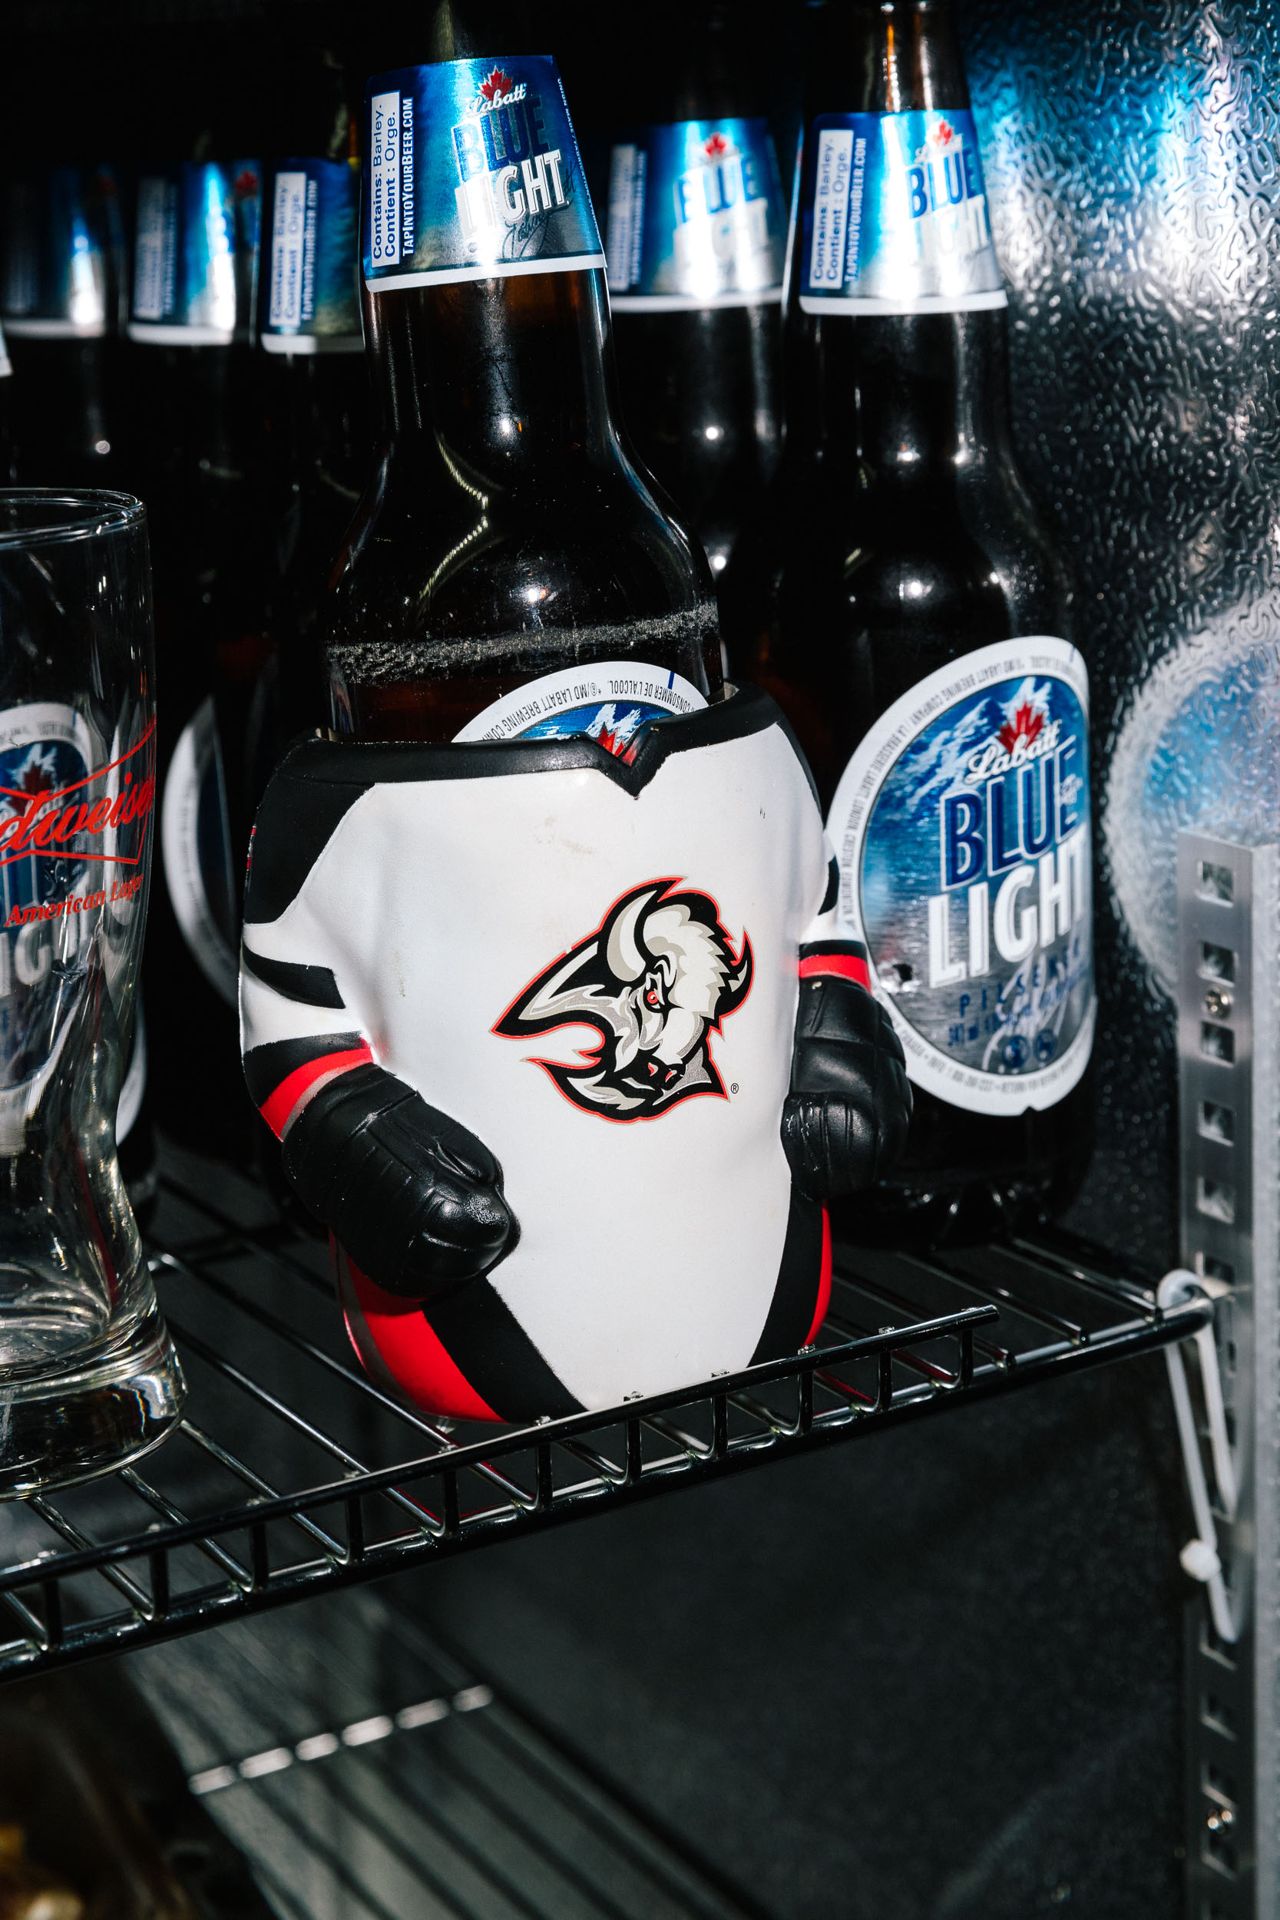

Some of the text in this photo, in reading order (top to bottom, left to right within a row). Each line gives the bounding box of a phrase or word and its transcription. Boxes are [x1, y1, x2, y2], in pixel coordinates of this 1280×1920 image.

[464, 83, 527, 115] Labatt
[385, 112, 397, 162] Orge.
[452, 96, 549, 184] BLUE
[373, 104, 384, 260] Contains: Barley.
[455, 149, 567, 236] LIGHT
[906, 148, 981, 219] BLUE
[385, 178, 396, 258] Contient
[827, 209, 842, 281] Contient
[502, 701, 541, 732] BREWING
[541, 687, 573, 712] LABATT
[964, 719, 1063, 785] Labatt
[938, 735, 1078, 892] BLUE
[4, 890, 106, 928] American
[927, 823, 1088, 989] LIGHT
